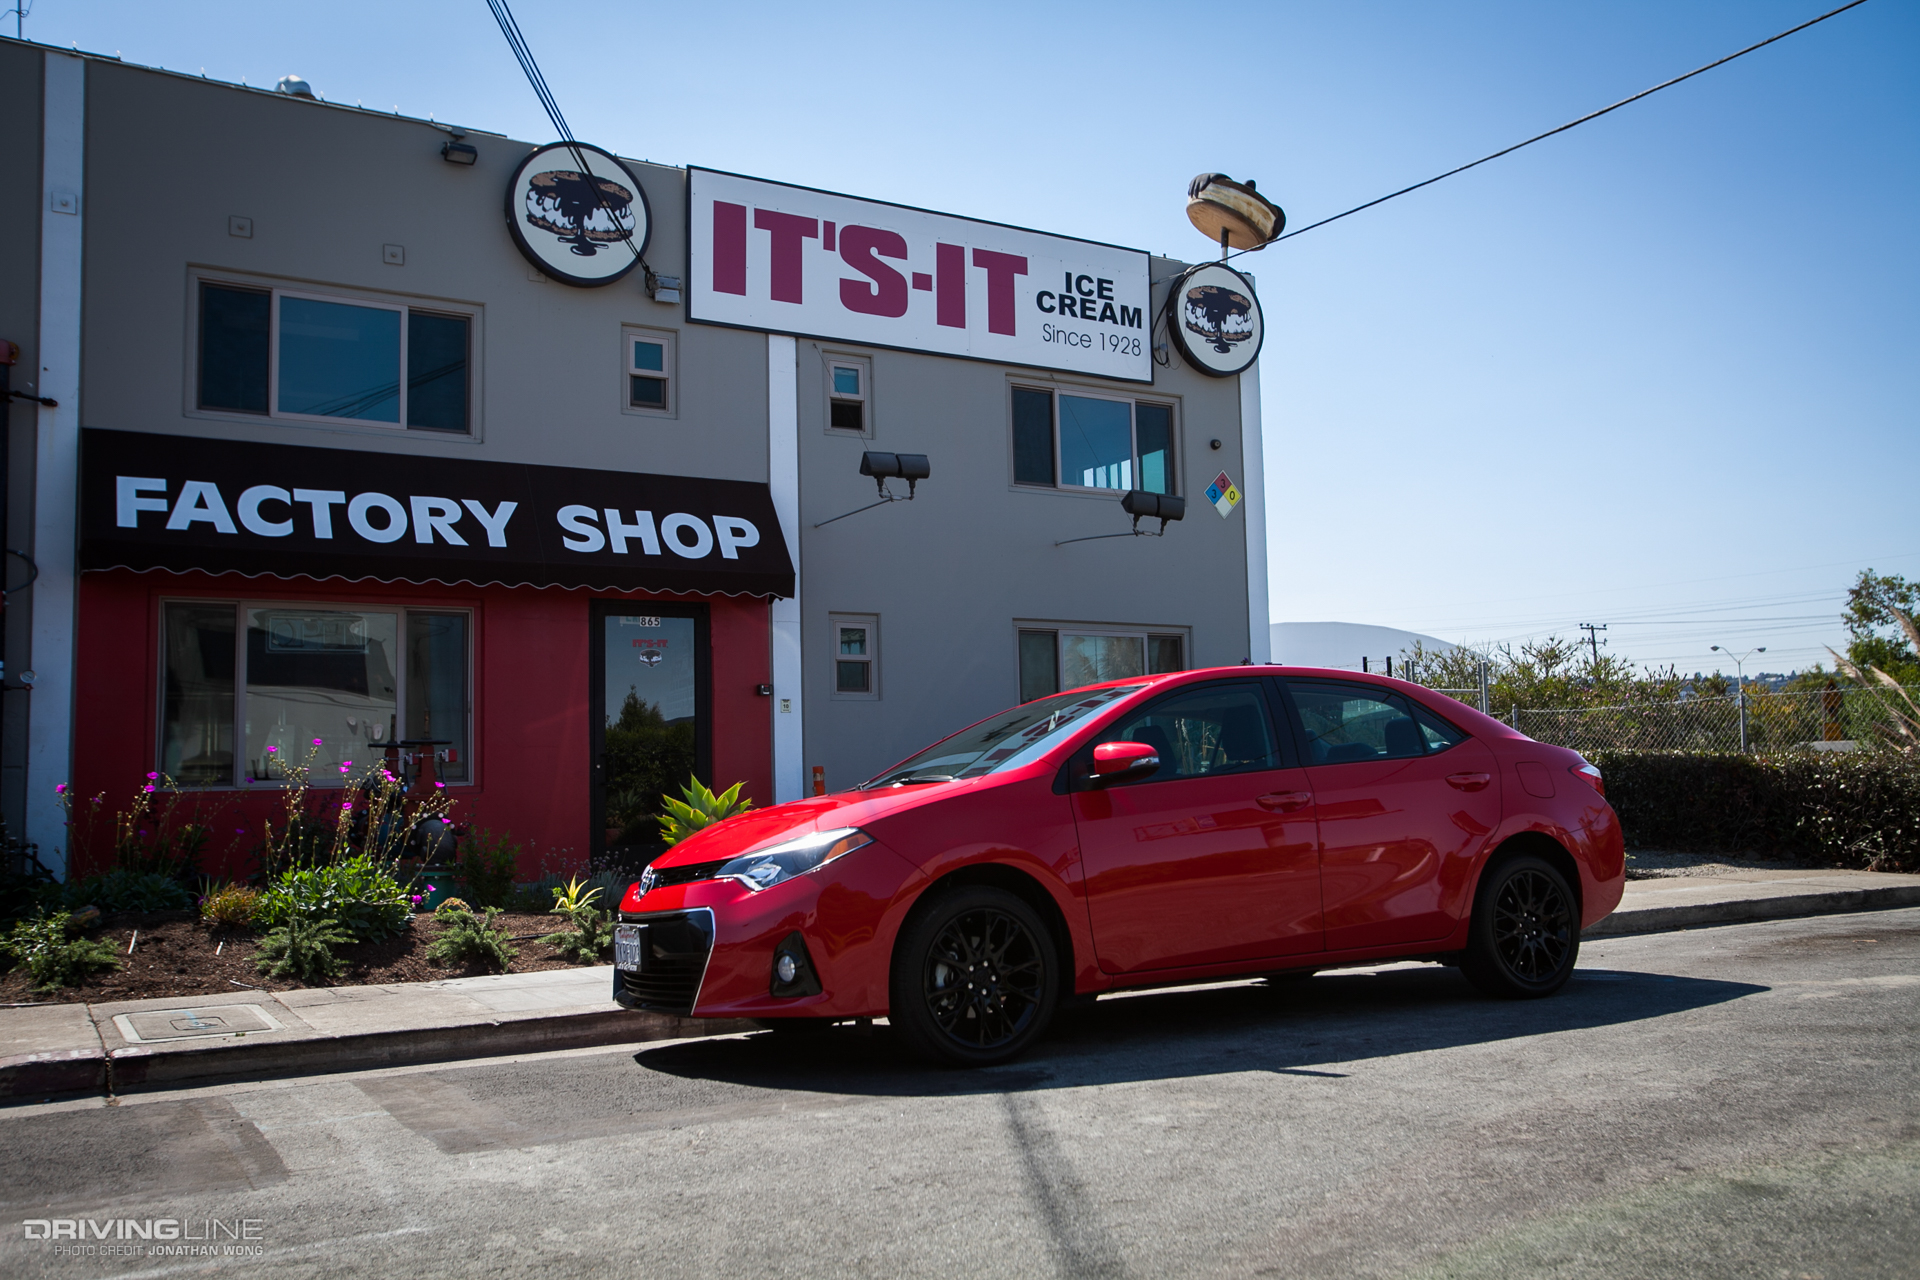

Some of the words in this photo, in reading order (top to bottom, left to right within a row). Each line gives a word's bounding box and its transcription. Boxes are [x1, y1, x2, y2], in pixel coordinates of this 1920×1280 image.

[713, 200, 1028, 337] IT'S-IT
[1065, 271, 1114, 301] ICE
[1036, 290, 1142, 329] CREAM
[1043, 323, 1092, 348] Since
[1099, 332, 1142, 356] 1928
[1211, 489, 1217, 499] 3
[1220, 478, 1226, 489] 3
[1229, 490, 1236, 501] 0
[116, 475, 518, 547] FACTORY
[556, 503, 760, 559] SHOP
[640, 617, 660, 626] 865
